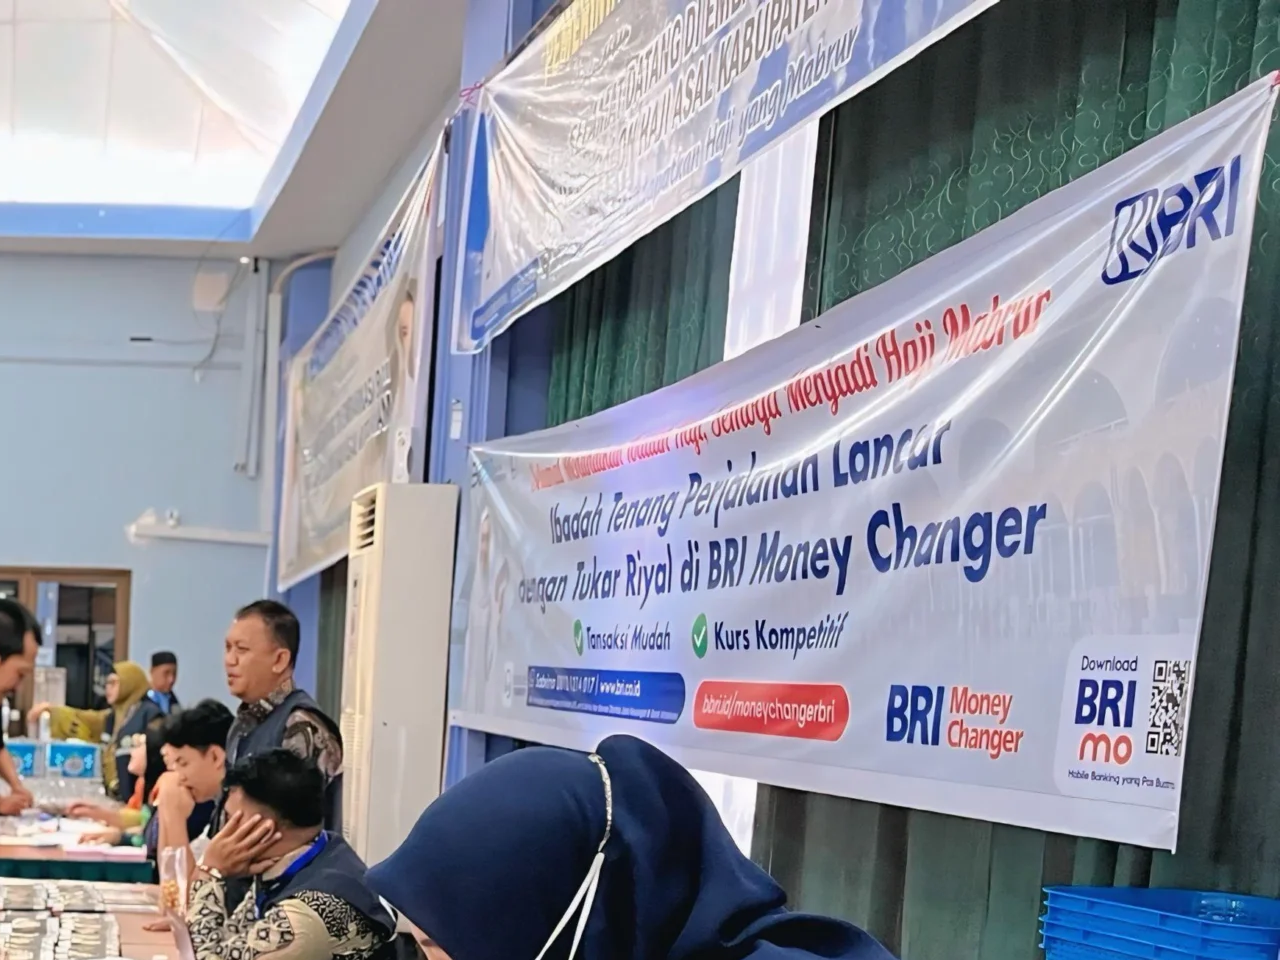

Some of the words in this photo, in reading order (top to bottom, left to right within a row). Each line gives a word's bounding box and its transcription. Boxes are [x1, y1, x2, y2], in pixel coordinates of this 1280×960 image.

[672, 52, 713, 131] ASAL
[718, 0, 827, 92] KABUPAT
[738, 82, 781, 148] yang
[782, 25, 858, 112] Mabrur
[876, 320, 935, 388] Haji
[550, 492, 602, 544] Ibadah
[607, 492, 679, 537] Tenang
[679, 451, 819, 528] Perjalanan
[832, 420, 951, 487] Lancar
[572, 556, 620, 600] Tukar
[626, 544, 671, 609] Riyal
[681, 540, 699, 593] di
[707, 531, 747, 590] BRI
[749, 530, 852, 596] Money
[867, 503, 1047, 583] Changer
[631, 621, 671, 651] Mudah
[714, 621, 750, 650] Kurs
[755, 611, 849, 660] Kompetitif
[1081, 655, 1138, 672] Download
[886, 684, 945, 746] BRI
[949, 686, 1013, 725] Money
[1074, 678, 1137, 728] BRI
[947, 719, 1024, 760] Changer
[1079, 732, 1133, 765] mo
[1091, 771, 1120, 785] Banking
